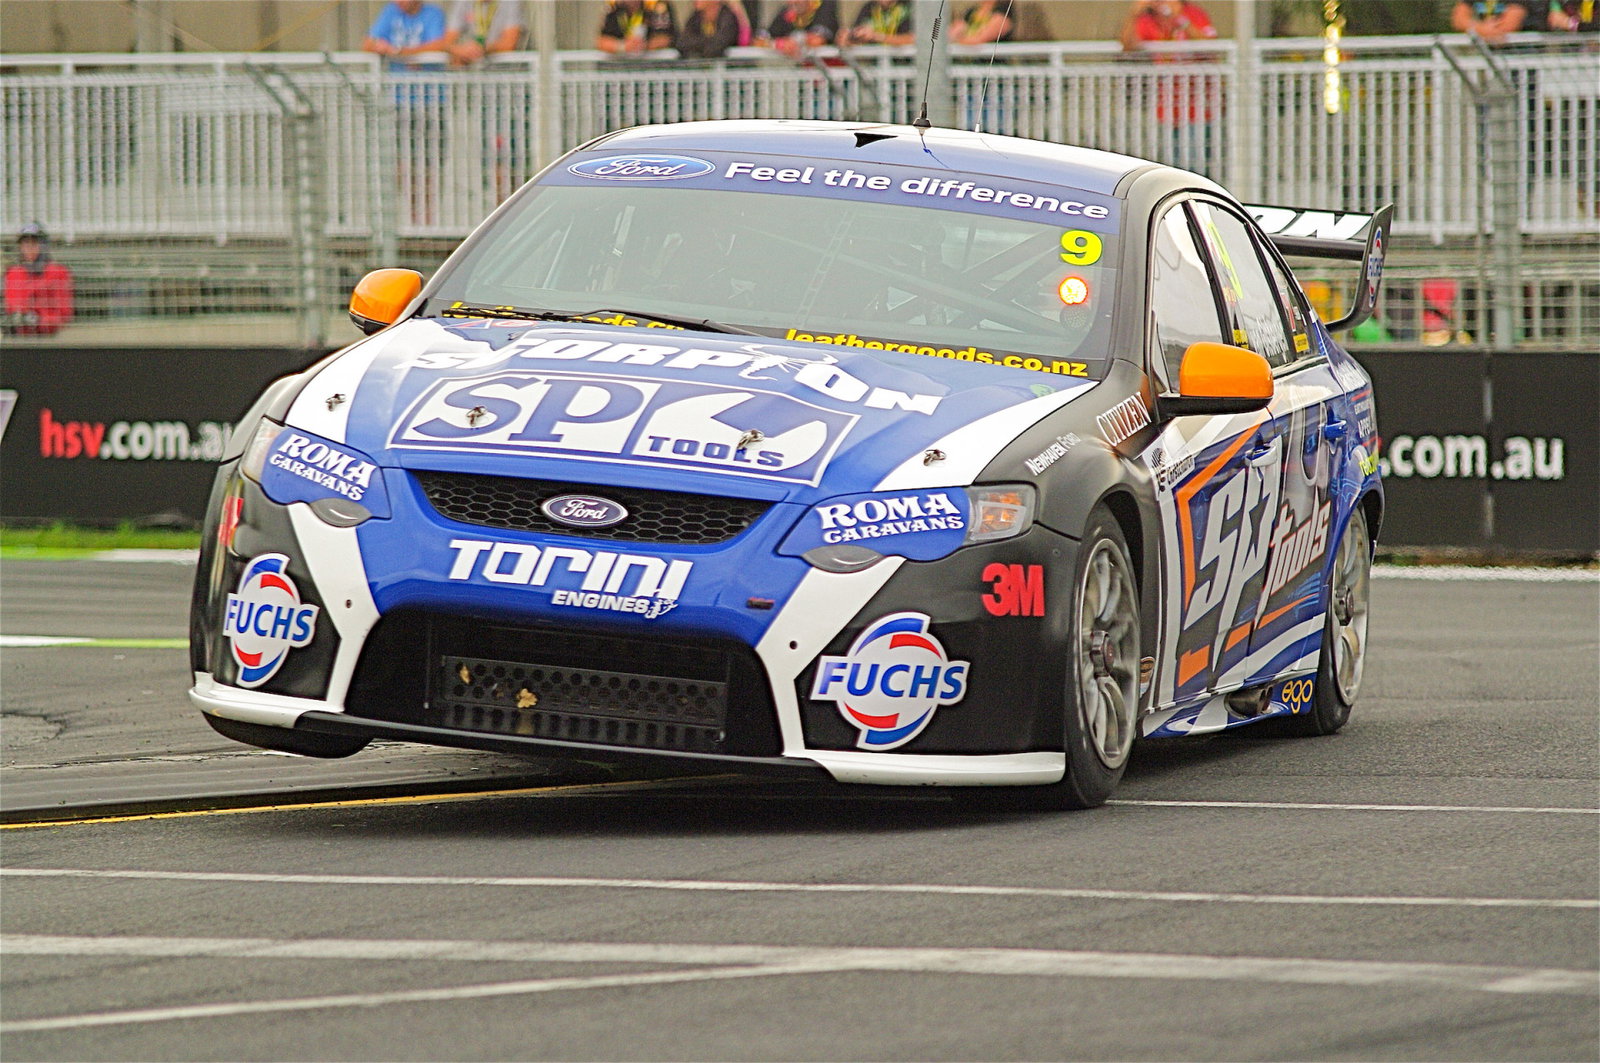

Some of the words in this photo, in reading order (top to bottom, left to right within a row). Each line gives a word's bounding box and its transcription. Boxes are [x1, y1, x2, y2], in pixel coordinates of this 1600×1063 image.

[595, 158, 687, 177] Ford
[725, 162, 814, 184] Feel
[824, 169, 892, 190] the
[900, 176, 1110, 219] difference
[1059, 229, 1104, 267] 9
[784, 328, 1089, 377] leathergoods.co.nz
[411, 375, 645, 444] SP
[648, 434, 785, 468] TOOLS
[1096, 391, 1152, 447] CITIZEN
[269, 453, 366, 501] CARAVANS
[278, 433, 377, 489] ROMA
[559, 499, 608, 520] Ford
[815, 492, 961, 530] ROMA
[822, 515, 965, 544] CARAVANS
[449, 539, 694, 601] TORINI
[981, 562, 1046, 617] 3M
[225, 599, 314, 642] FUCHS
[551, 589, 651, 615] ENGINES
[817, 662, 965, 699] FUCHS
[1281, 679, 1313, 714] ego
